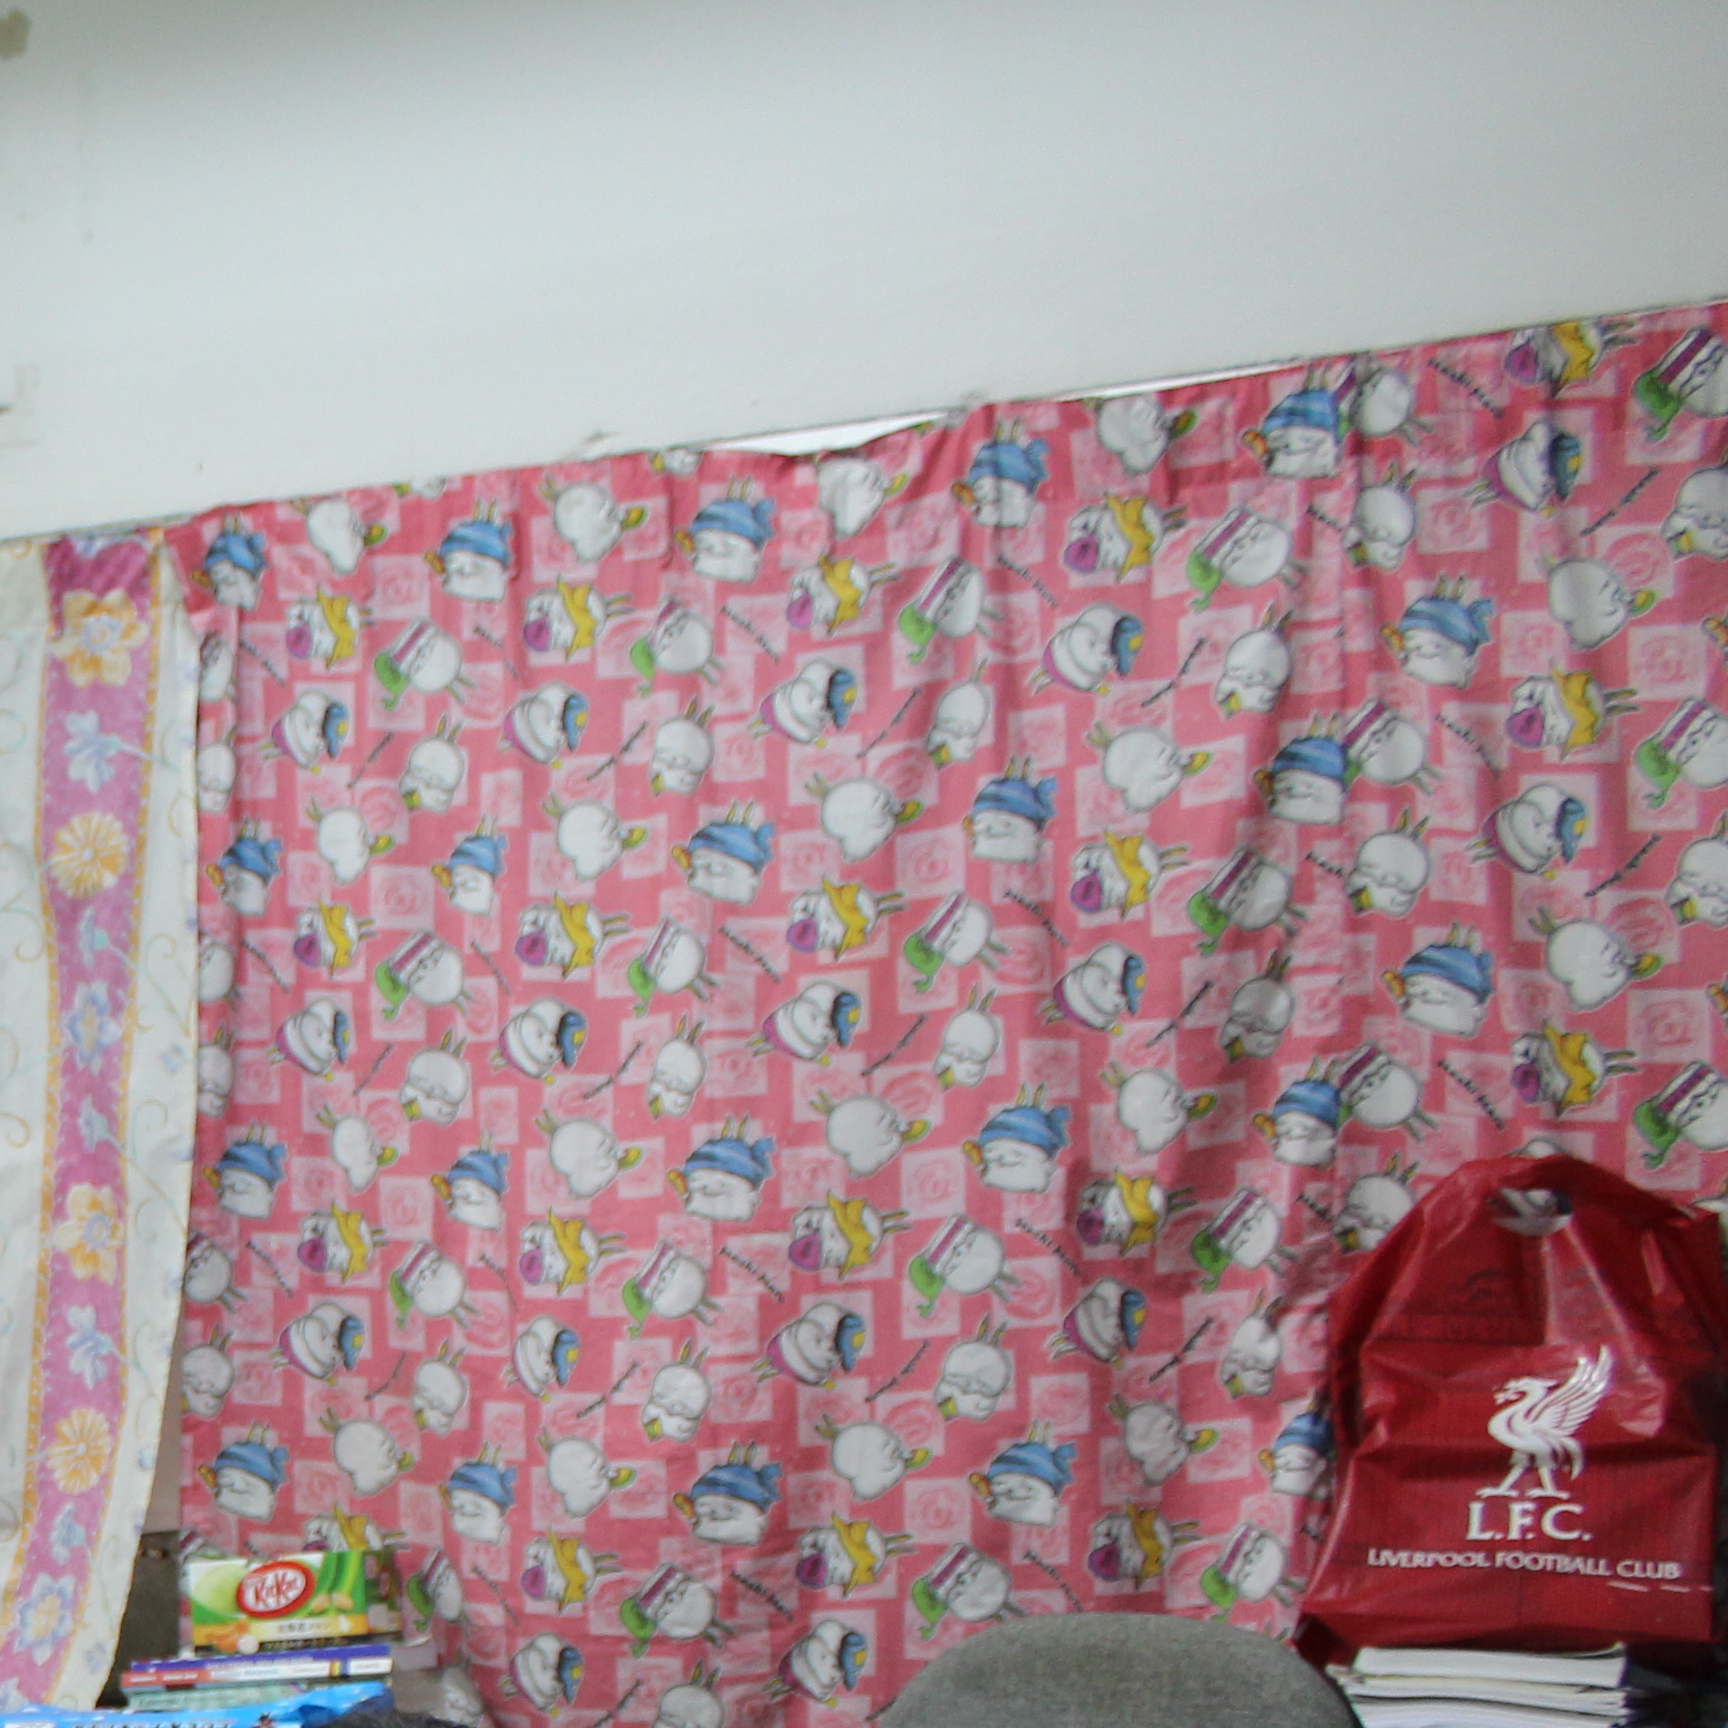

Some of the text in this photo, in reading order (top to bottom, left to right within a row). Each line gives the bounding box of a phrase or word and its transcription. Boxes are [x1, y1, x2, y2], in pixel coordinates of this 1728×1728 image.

[1466, 1501, 1593, 1542] L.F.C.
[1366, 1547, 1683, 1579] LIVERPOOL FOOTBALL CLUB
